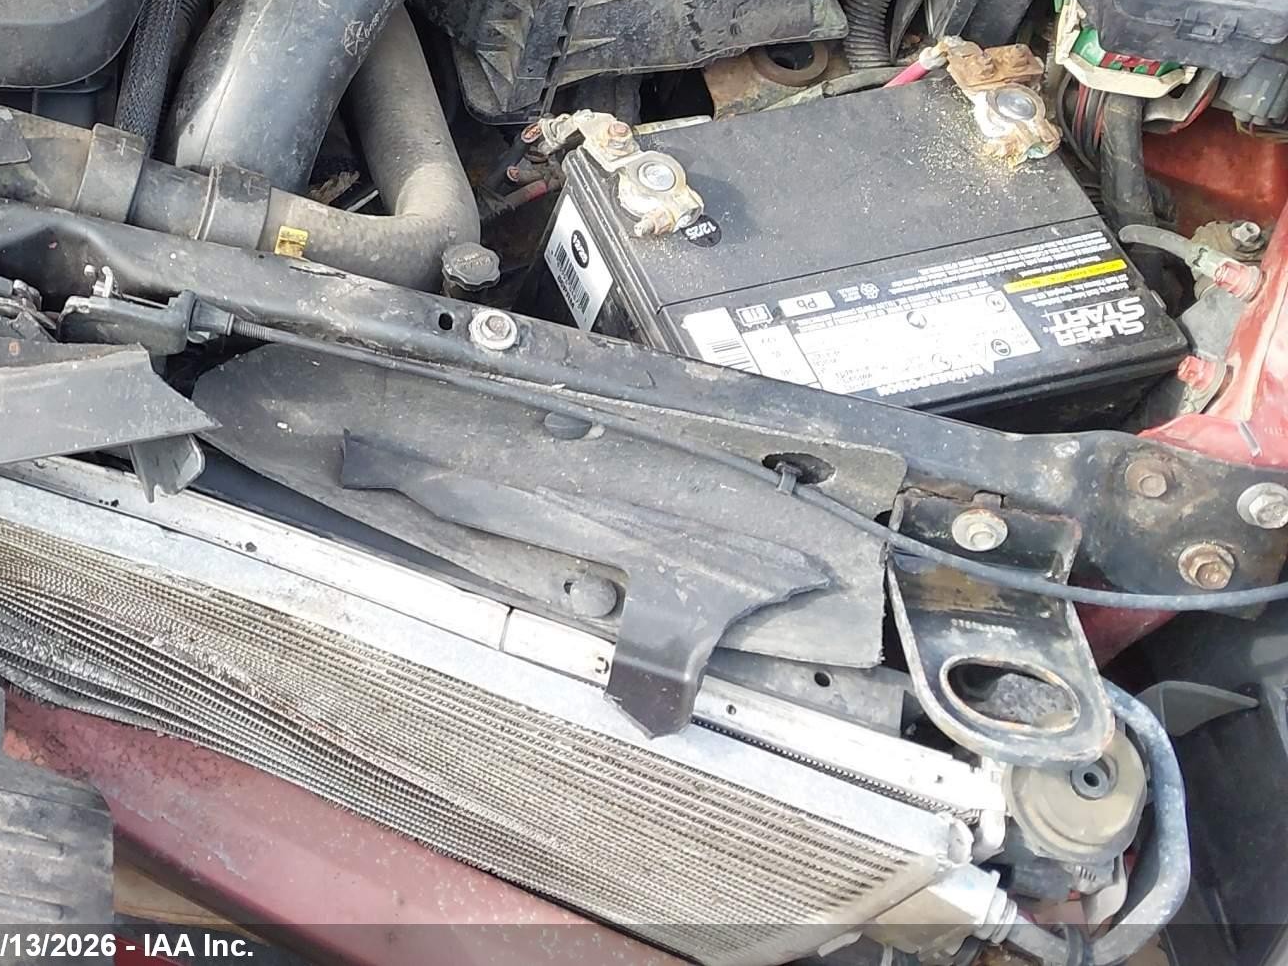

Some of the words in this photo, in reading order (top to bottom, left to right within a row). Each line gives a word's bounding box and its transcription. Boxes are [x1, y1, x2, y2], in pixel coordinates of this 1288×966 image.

[685, 221, 717, 240] 12/25
[796, 297, 818, 311] Pb
[1048, 296, 1146, 334] START
[1054, 318, 1145, 347] SUPER
